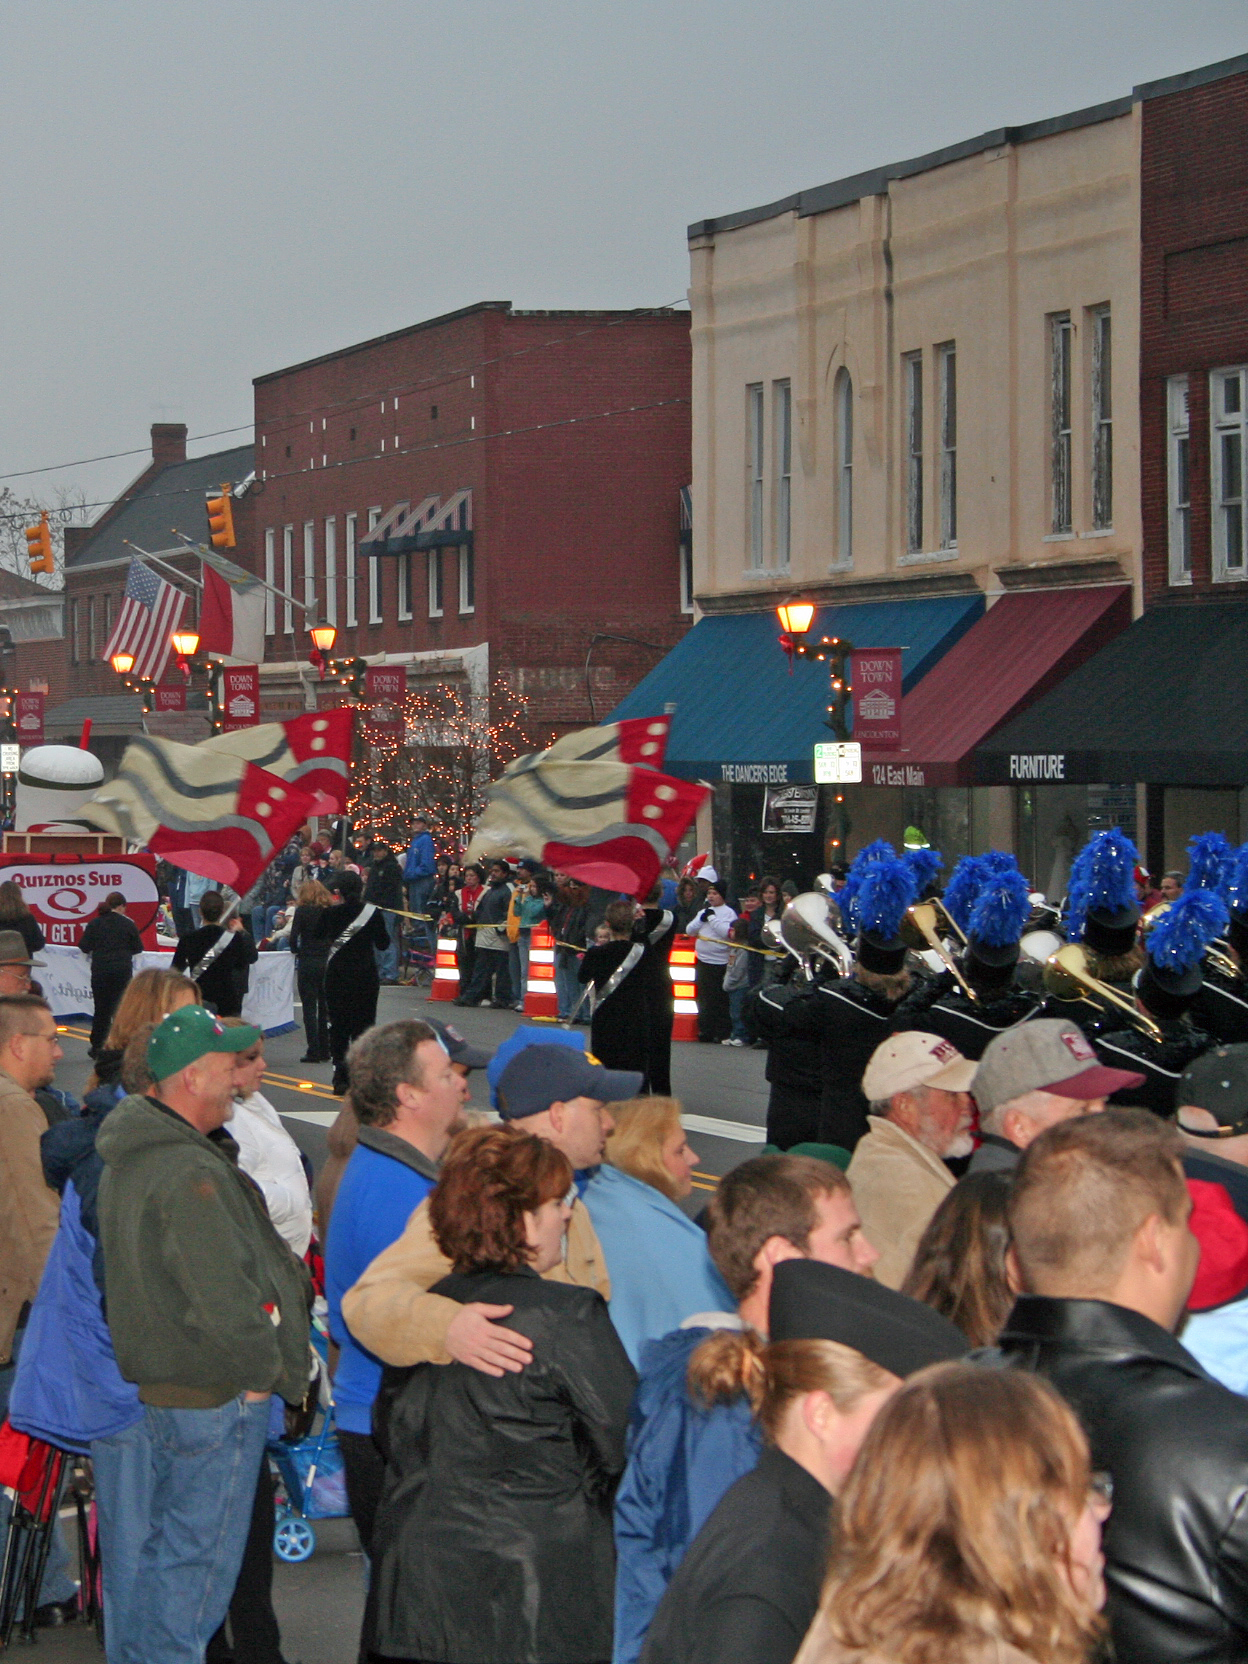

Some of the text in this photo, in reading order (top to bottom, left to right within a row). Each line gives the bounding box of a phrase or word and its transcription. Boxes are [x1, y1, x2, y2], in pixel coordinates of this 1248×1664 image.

[859, 660, 893, 672] DOWN
[230, 675, 253, 683] DOWN
[373, 675, 399, 684] DOWN
[860, 672, 892, 683] TOWN
[231, 683, 253, 691] TOWN
[373, 684, 399, 693] TOWN
[160, 691, 181, 699] DOWN
[160, 698, 181, 706] TOWN
[1010, 755, 1065, 779] FURNITURE
[721, 764, 788, 783] THE DANCER'S EDGE
[872, 765, 886, 785] 124
[887, 765, 905, 786] East
[906, 766, 925, 786] Main
[11, 871, 123, 888] QUIZNOS SUB
[52, 924, 76, 943] GET
